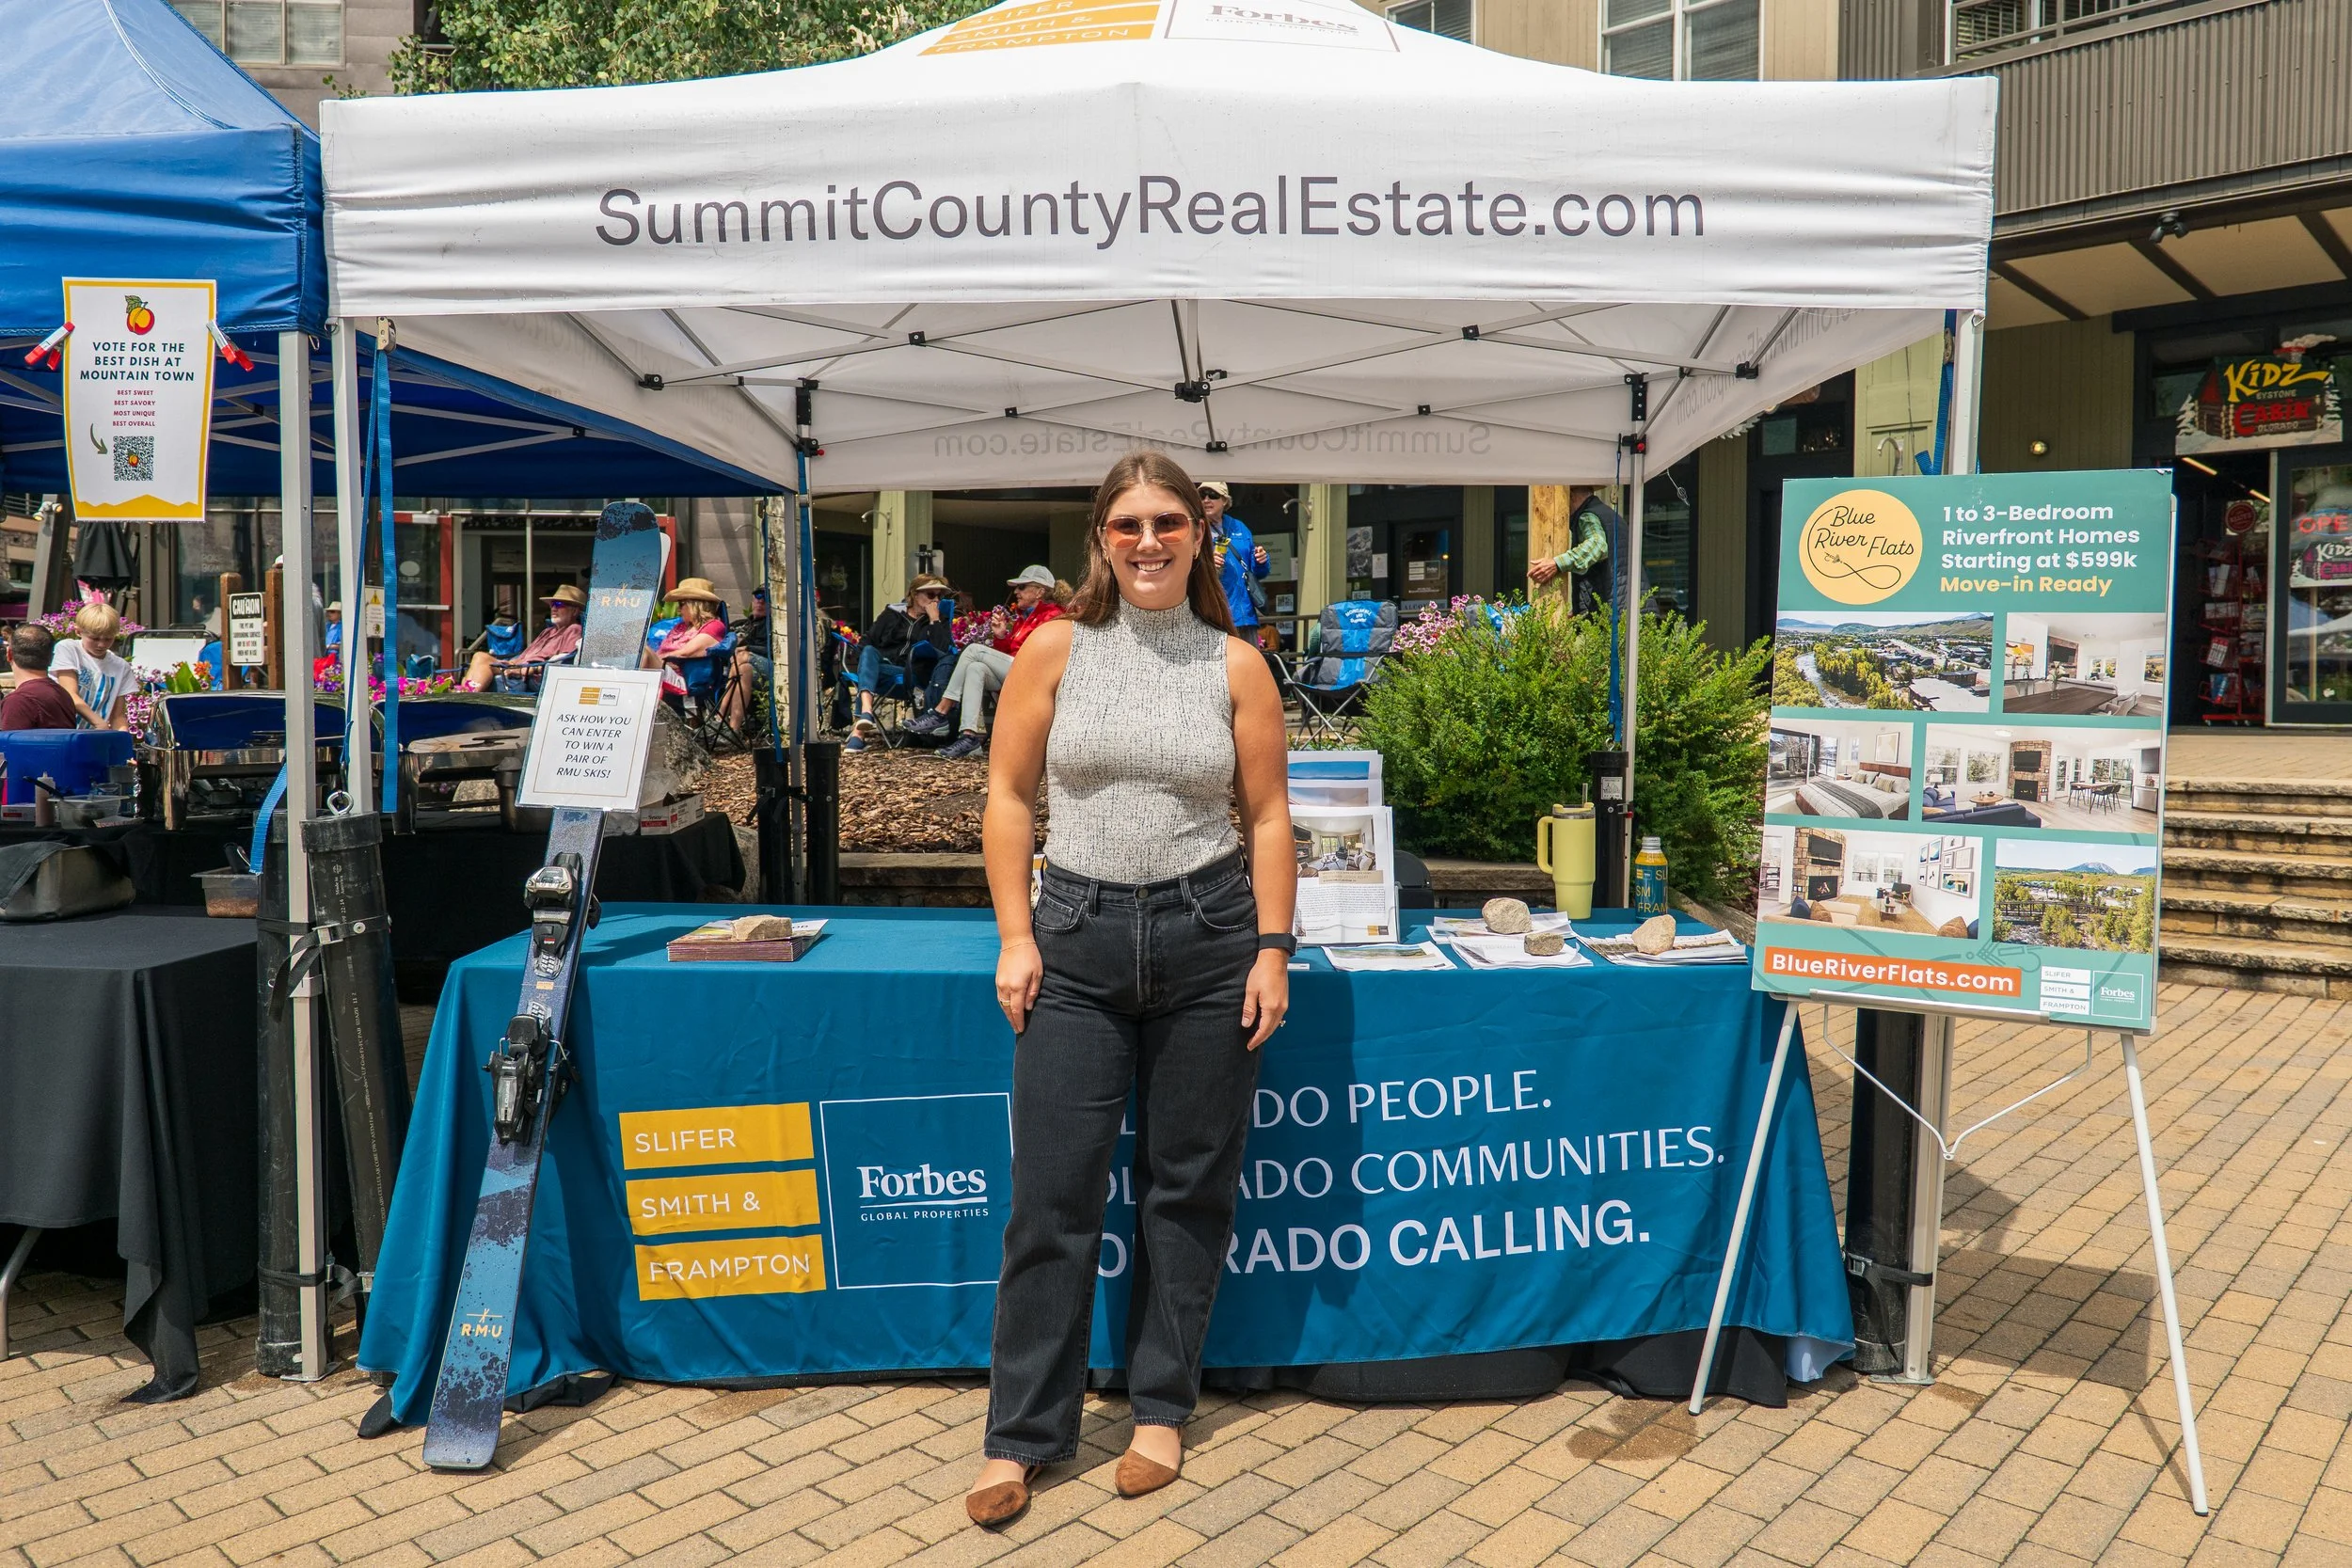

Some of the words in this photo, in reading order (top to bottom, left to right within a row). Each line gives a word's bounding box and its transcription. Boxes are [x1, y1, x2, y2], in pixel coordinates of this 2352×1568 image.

[966, 1, 1073, 26] SLIFER
[1210, 5, 1359, 31] Forbes
[954, 21, 1056, 40] SMITH
[935, 29, 1129, 53] FRAMPTON
[596, 174, 1704, 249] SummitCountyRealEstate.com
[93, 341, 128, 353] VOTE
[131, 341, 157, 353] FOR
[162, 341, 185, 353] THE
[94, 356, 126, 367] BEST
[129, 356, 161, 367] DISH
[164, 356, 182, 368] AT
[80, 371, 150, 381] MOUNTAIN
[154, 371, 195, 381] TOWN
[1830, 505, 1876, 528] Blue
[1943, 506, 1951, 522] 1
[1955, 506, 1979, 522] to
[1983, 504, 2114, 522] 3-Bedroom
[2299, 515, 2349, 534] OPE
[1814, 528, 1867, 549] River
[1942, 529, 2054, 546] Riverfront
[2058, 527, 2140, 545] Homes
[1867, 535, 1915, 558] Flats
[1941, 552, 2031, 574] Starting
[2036, 553, 2061, 569] at
[2065, 551, 2137, 570] $599k
[1940, 576, 2034, 594] Move-in
[2039, 576, 2113, 597] Ready
[232, 597, 261, 616] CAUTION
[557, 714, 578, 722] ASK
[580, 715, 607, 724] HOW
[609, 716, 632, 725] YOU
[562, 727, 584, 736] CAN
[586, 728, 622, 738] ENTER
[565, 740, 580, 749] TO
[583, 741, 604, 751] WIN
[606, 742, 613, 751] A
[565, 753, 590, 763] PAIR
[592, 754, 608, 764] OF
[557, 768, 581, 777] RMU
[583, 768, 612, 778] SKIS!
[1772, 953, 2013, 992] BlueRiverFlats.com
[2044, 970, 2071, 978] SLIFER
[2043, 985, 2068, 993] SMITH
[2100, 986, 2136, 998] Forbes
[2042, 1001, 2086, 1011] FRAMPTON
[1348, 1069, 1552, 1124] PEOPLE.
[635, 1128, 737, 1153] SLIFER
[1351, 1126, 1725, 1196] COMMUNITIES.
[856, 1163, 987, 1198] Forbes
[641, 1193, 731, 1219] SMITH
[742, 1191, 761, 1212] &
[861, 1211, 909, 1222] GLOBAL
[914, 1208, 989, 1220] PROPERTIES
[1097, 1224, 1371, 1278] ORADO
[1389, 1199, 1650, 1267] CALLING.
[649, 1254, 810, 1283] FRAMPTON
